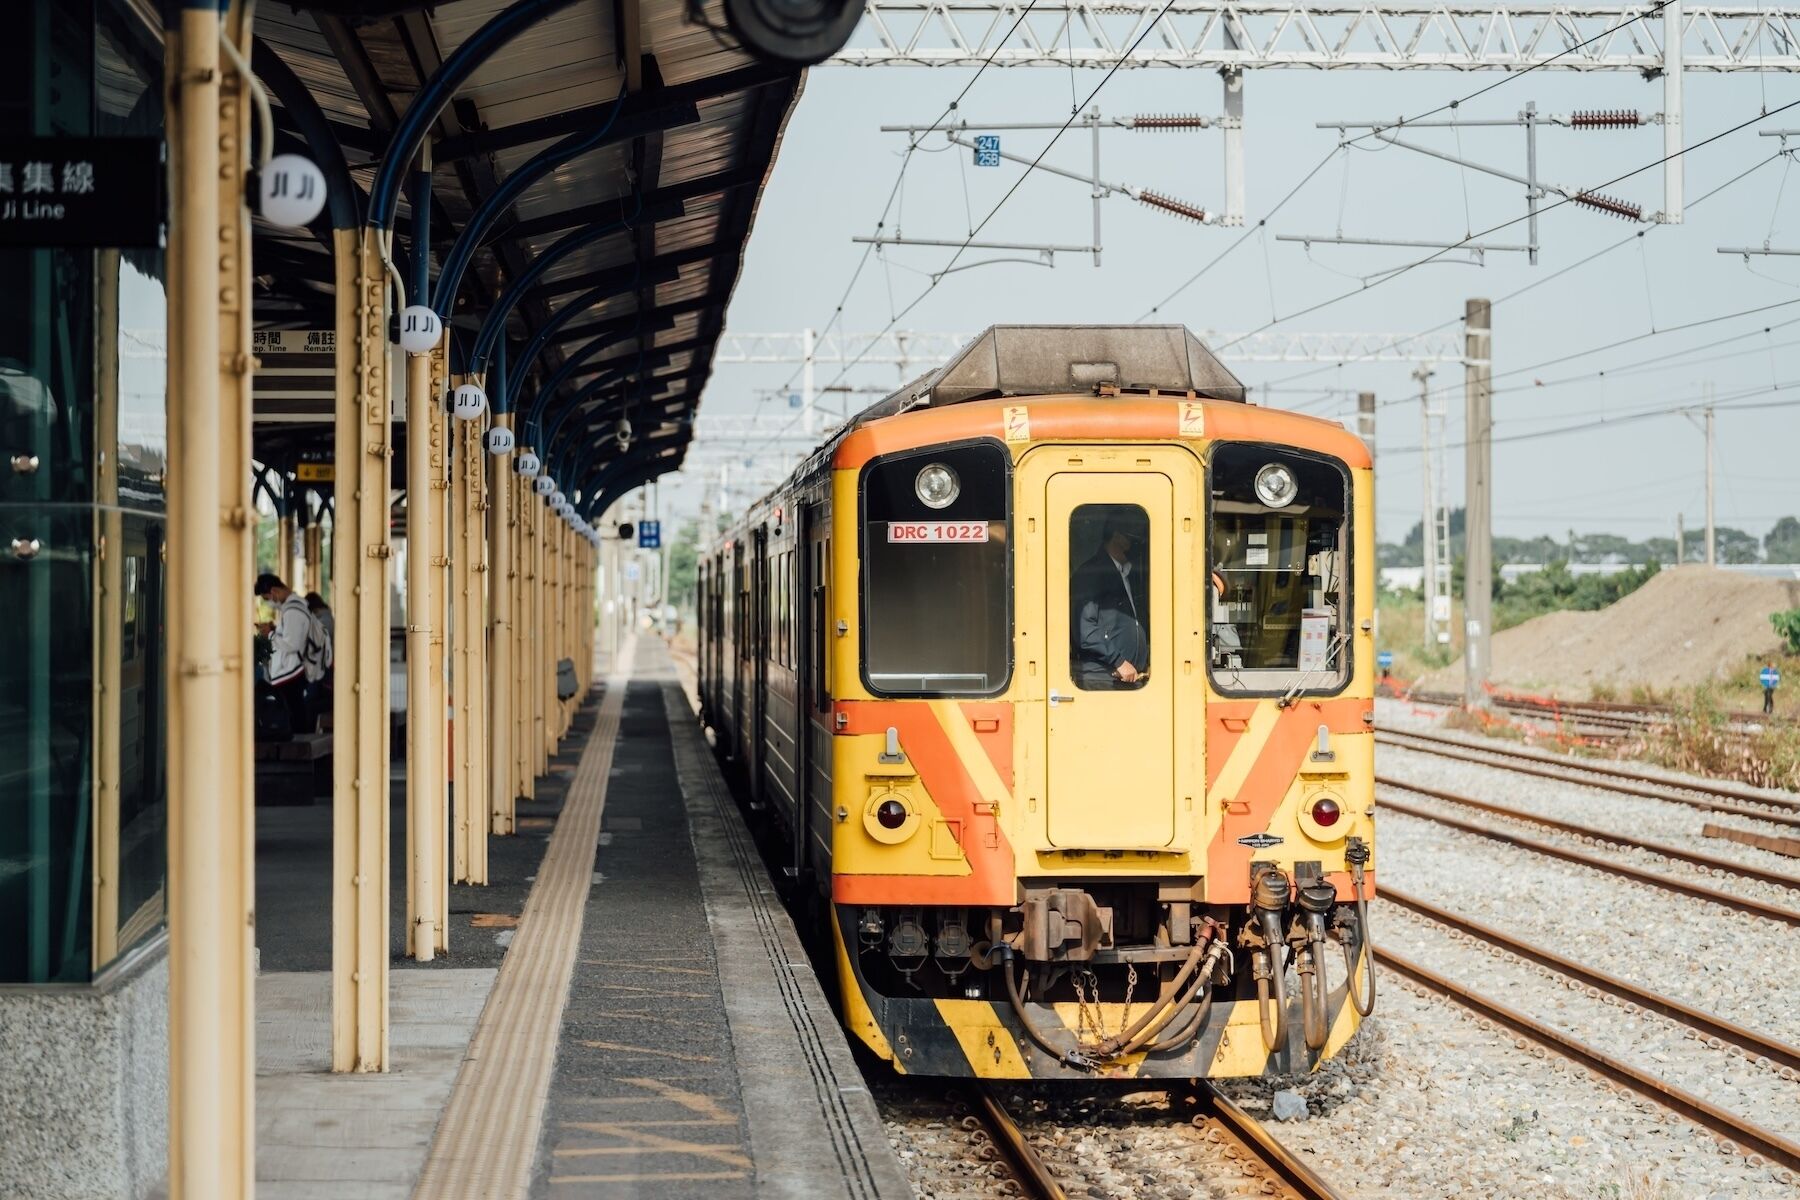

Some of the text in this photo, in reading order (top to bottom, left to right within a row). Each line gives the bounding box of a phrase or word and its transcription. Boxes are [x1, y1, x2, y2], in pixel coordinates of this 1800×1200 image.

[979, 136, 999, 150] 247
[22, 200, 65, 219] Line
[254, 331, 281, 344] 時間
[307, 332, 335, 345] 備註
[893, 526, 983, 539] DRC 1022
